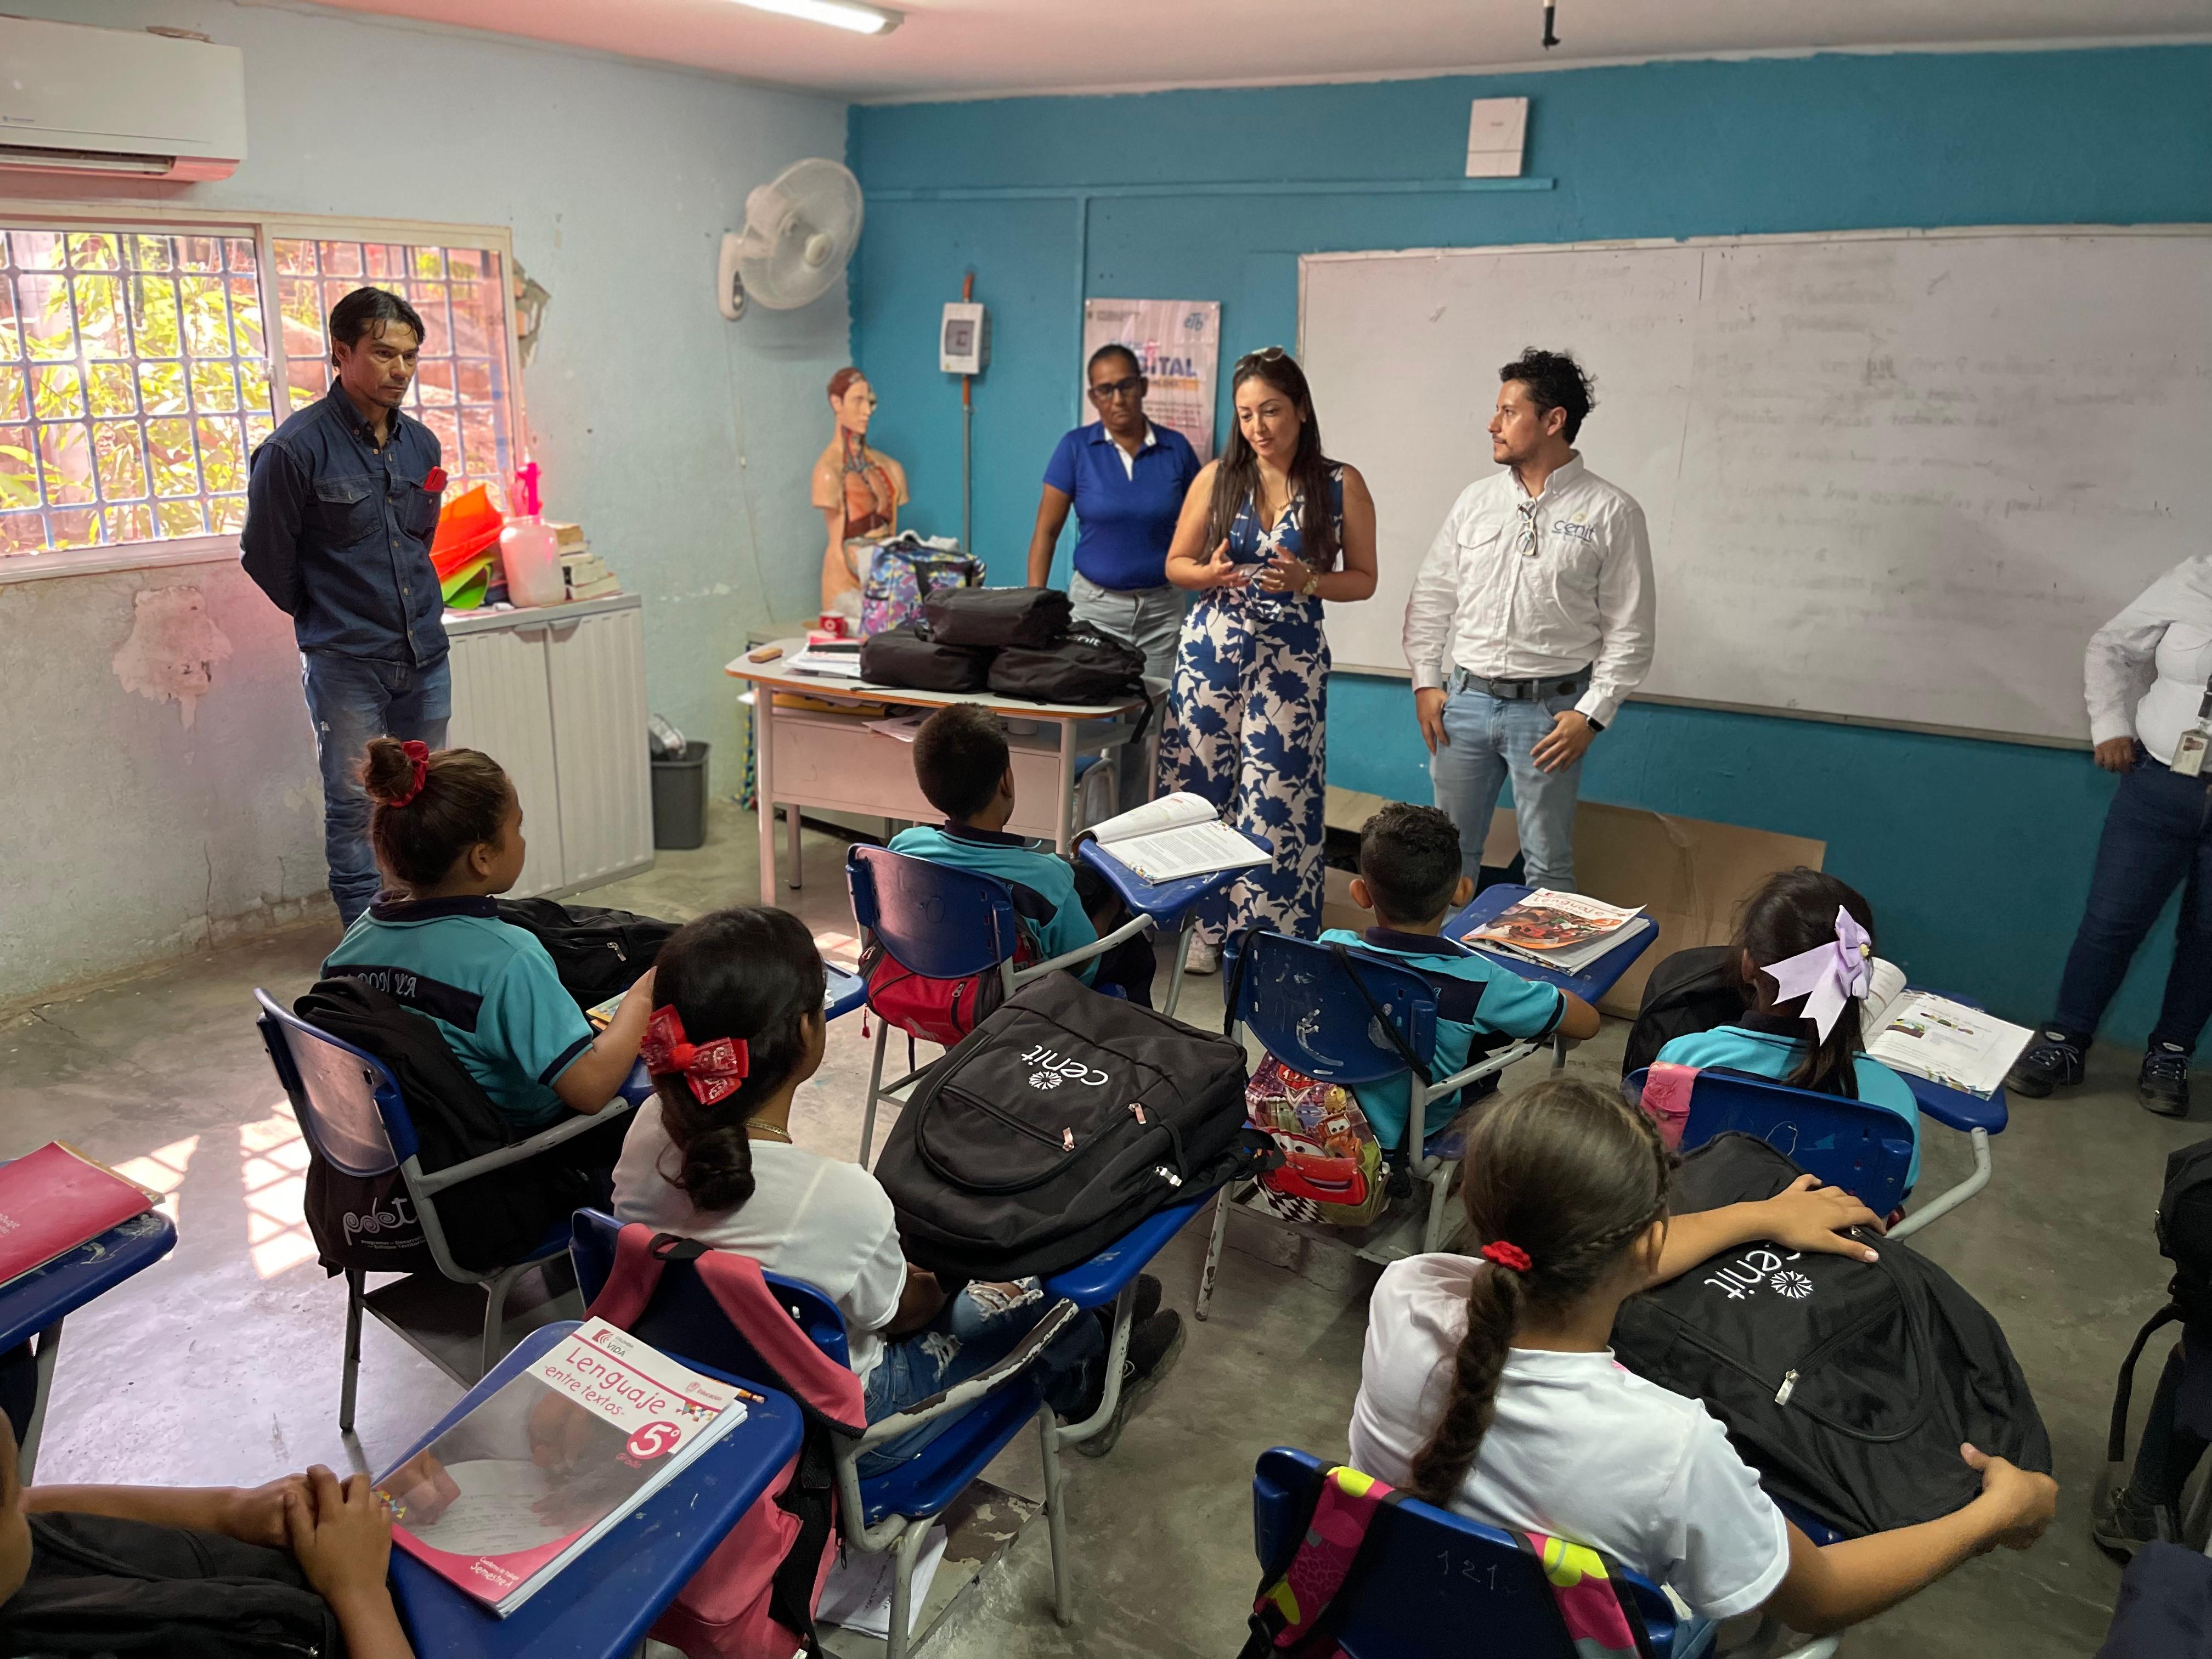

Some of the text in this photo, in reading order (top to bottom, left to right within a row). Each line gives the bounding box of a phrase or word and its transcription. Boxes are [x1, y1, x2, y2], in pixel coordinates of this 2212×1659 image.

[1554, 520, 1595, 540] cenit
[1021, 1045, 1109, 1086] cenit
[1703, 1244, 1801, 1300] enit
[607, 1342, 626, 1357] VIDA
[566, 1347, 666, 1414] Lenguaje
[616, 1452, 641, 1469] Grado
[470, 1561, 506, 1586] Semestre
